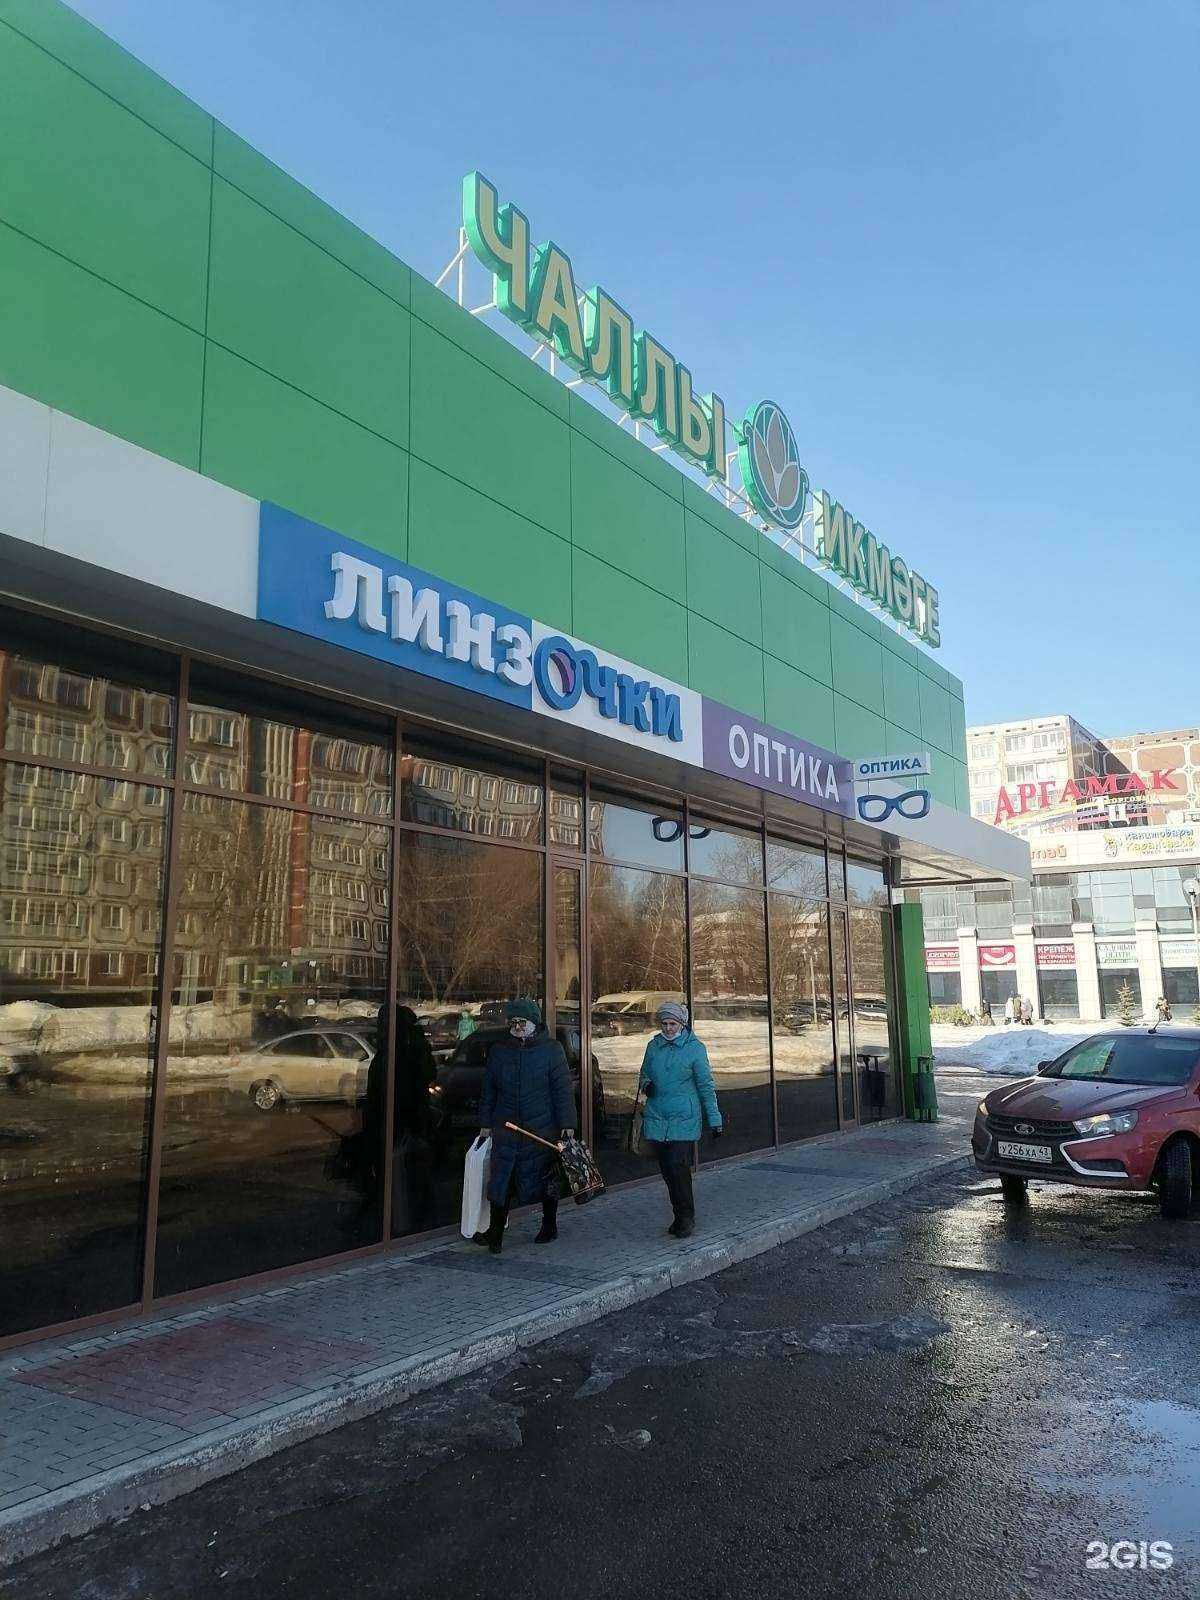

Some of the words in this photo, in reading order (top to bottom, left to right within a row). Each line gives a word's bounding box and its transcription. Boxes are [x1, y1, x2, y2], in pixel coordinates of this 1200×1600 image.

[462, 169, 727, 482] ЧАЛЛЫ
[728, 724, 839, 803] ОПТИКА
[859, 757, 922, 775] ОПТИКА
[994, 768, 1179, 826] АРГАМАК
[1037, 945, 1075, 955] КРЕПЕЖ
